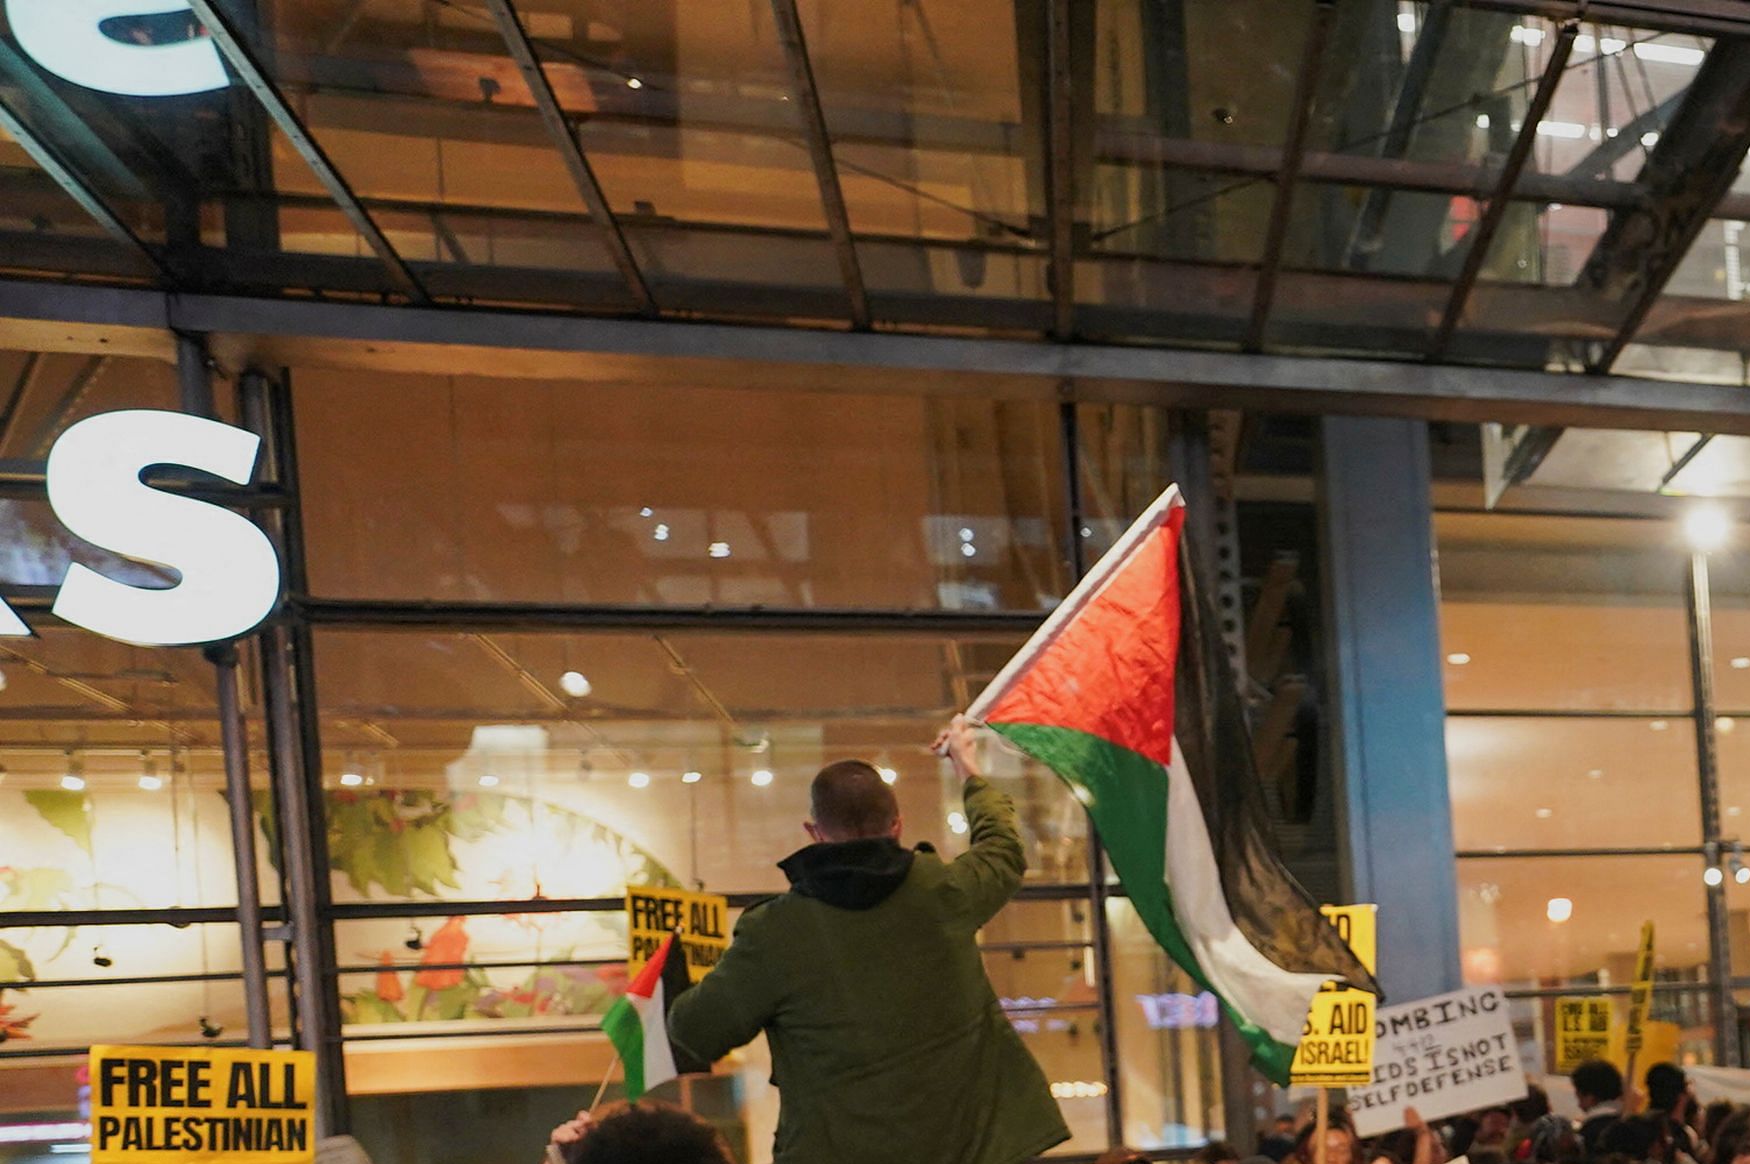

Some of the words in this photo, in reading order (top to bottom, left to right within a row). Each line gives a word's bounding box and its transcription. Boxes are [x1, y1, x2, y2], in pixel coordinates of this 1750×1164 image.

[0, 409, 281, 646] S
[631, 895, 684, 933] FREE
[690, 901, 724, 939] ALL
[1329, 1002, 1367, 1036] AID
[1376, 992, 1500, 1038] OMBING
[1300, 1040, 1368, 1065] ISRAEL!
[1364, 1060, 1418, 1088] IDS
[1462, 1033, 1508, 1059] NOT
[101, 1058, 212, 1108] FREE
[227, 1061, 307, 1110] ALL
[99, 1116, 306, 1152] PALESTINIAN
